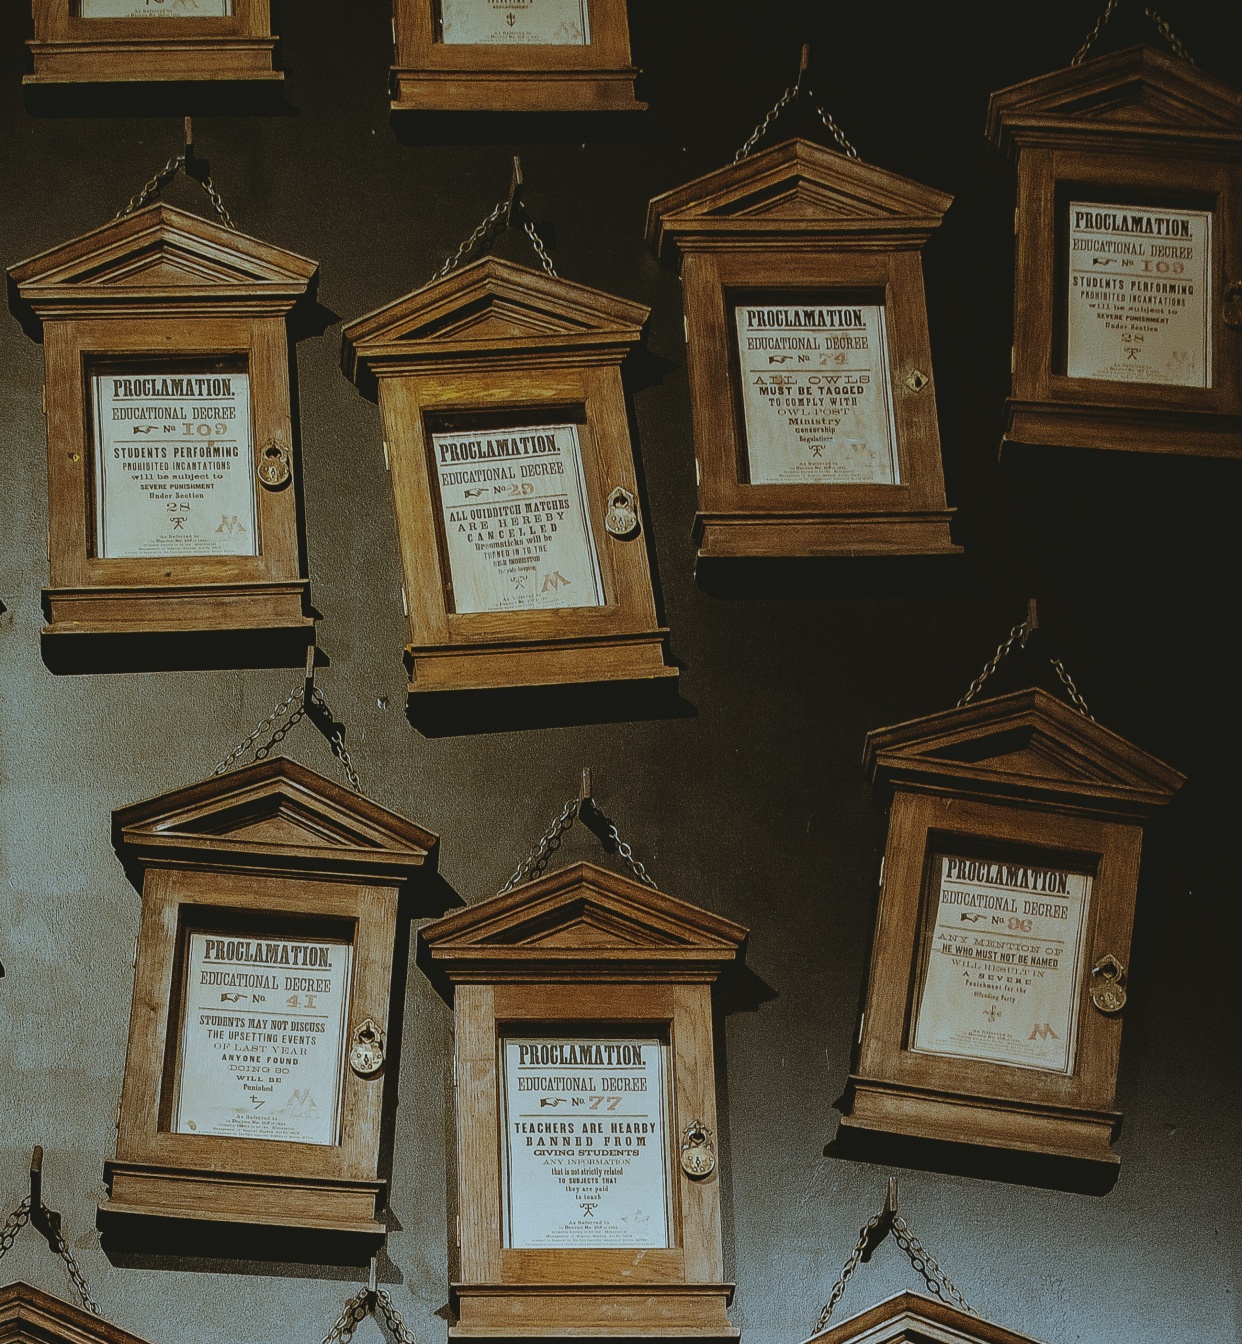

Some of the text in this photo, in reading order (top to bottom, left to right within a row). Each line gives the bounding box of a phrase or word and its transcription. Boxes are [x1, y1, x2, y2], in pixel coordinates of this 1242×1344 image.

[1075, 211, 1193, 238] PROCLAMATION.
[1073, 238, 1193, 260] EDUCATIONAL DECREE
[1073, 276, 1194, 295] STUDENTS PERFORMING
[747, 309, 866, 327] PROCLAMATION.
[747, 336, 868, 350] EDUCATIONAL DECREE
[112, 378, 235, 397] PROCLAMATION.
[752, 375, 870, 385] ALL OWLS
[759, 386, 864, 395] MUST BE TAGGED
[786, 398, 824, 406] COMPLY
[830, 397, 857, 406] WITH
[112, 407, 236, 420] EDUCATIONAL DECREE
[182, 423, 227, 436] 109
[788, 418, 841, 426] Ministry
[114, 447, 238, 459] STUDENTS PERFORMING
[439, 434, 560, 462] PROCLAMATION.
[122, 462, 231, 470] PROHIBITED INCANTATIONS
[441, 462, 564, 486] EDUCATIONAL DECREE
[166, 502, 190, 512] 28
[450, 499, 570, 522] ALL QUIDDITCH MATCHES
[458, 512, 565, 532] ARE HEREBY
[467, 524, 558, 542] CANCELLED
[946, 859, 1070, 895] PROCLAMATION.
[941, 890, 1068, 920] EDUCATIONAL DECREE
[204, 939, 332, 968] PROCLAMATION.
[942, 944, 1058, 968] HE WHO MUST NOT BE NAMED
[200, 971, 331, 993] EDUCATIONAL DECREE
[200, 1015, 325, 1033] STUDENTS MAY NOT DISCUSS
[208, 1029, 316, 1045] THE UPSETTING EVENTS
[234, 1044, 267, 1053] LAST
[273, 1046, 307, 1055] YEAR
[518, 1045, 646, 1065] PROCLAMATION.
[222, 1054, 299, 1065] ANYONE FOUND
[518, 1077, 647, 1092] EDUCATIONAL DECREE
[588, 1096, 622, 1110] 77
[514, 1122, 656, 1134] TEACHERS ARE HEARBY
[526, 1137, 646, 1146] BANNED FROM
[551, 1168, 623, 1177] that is not strictly related
